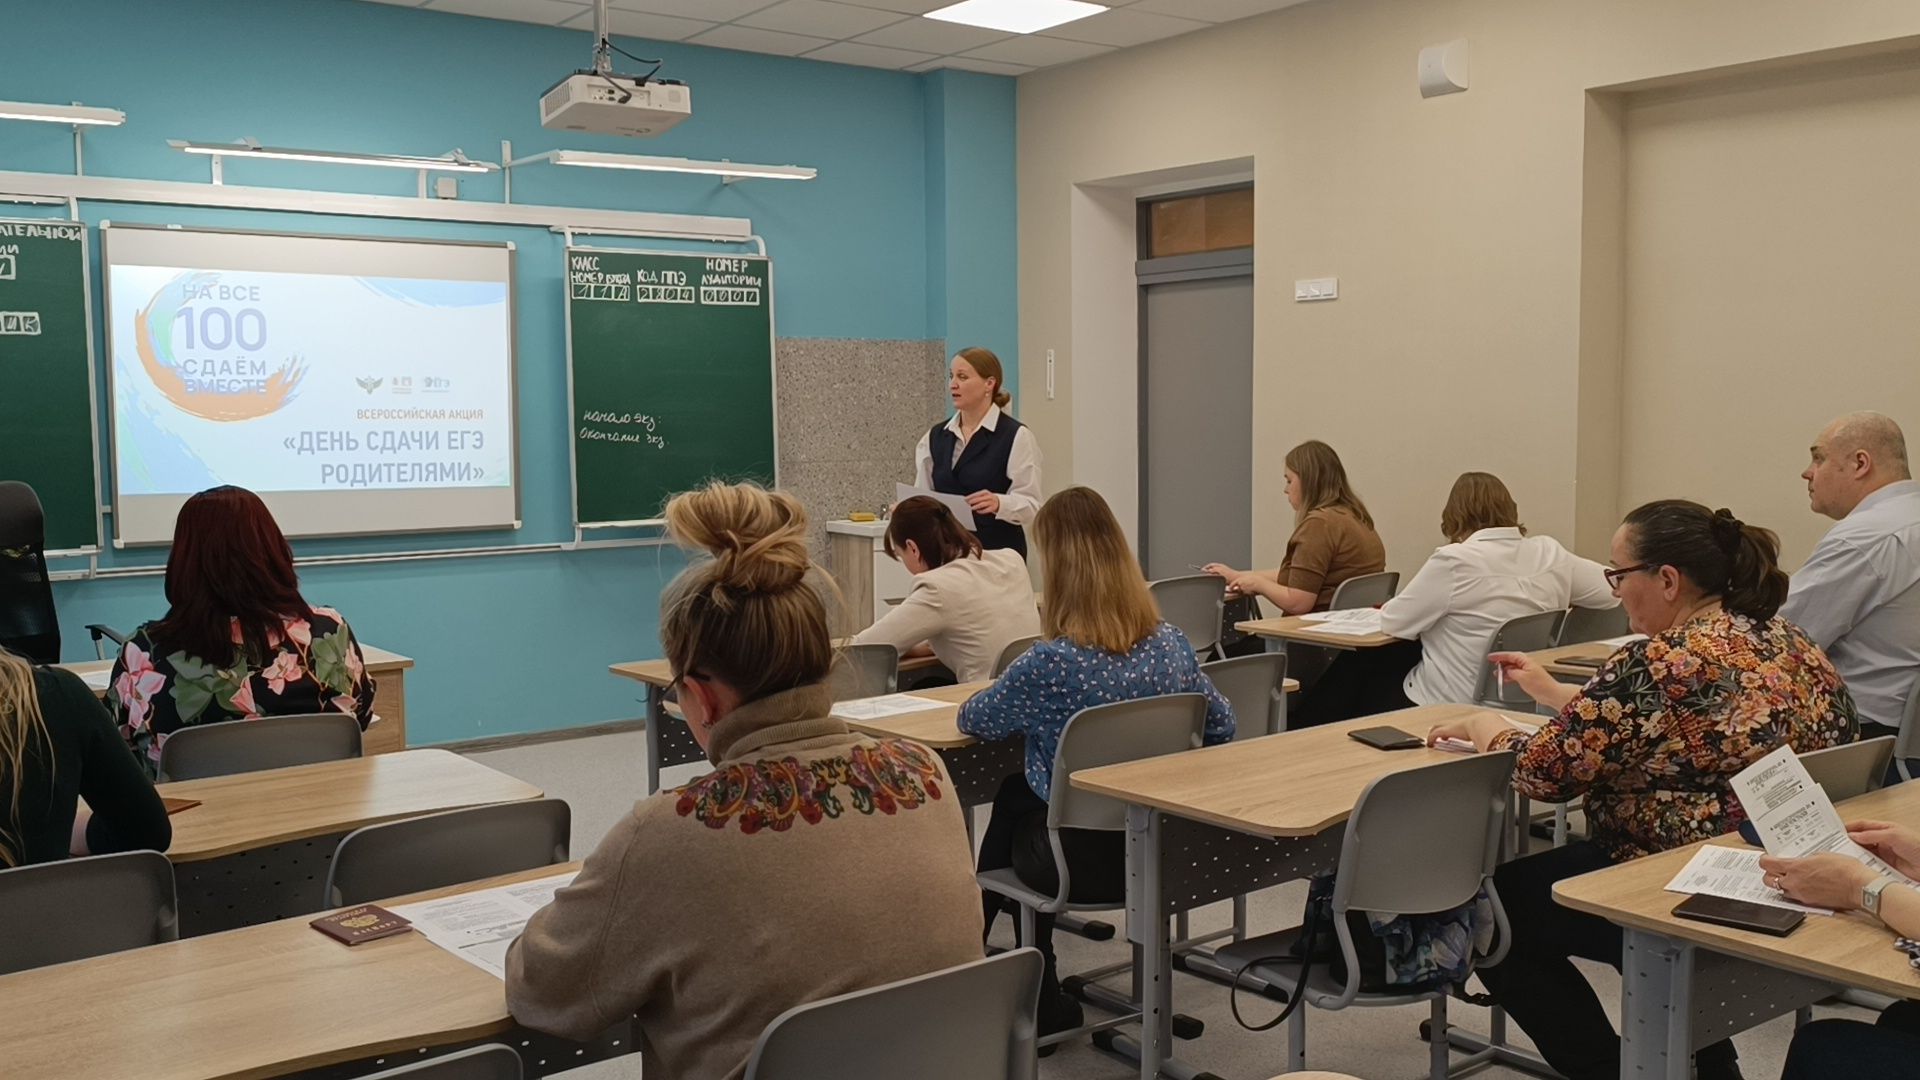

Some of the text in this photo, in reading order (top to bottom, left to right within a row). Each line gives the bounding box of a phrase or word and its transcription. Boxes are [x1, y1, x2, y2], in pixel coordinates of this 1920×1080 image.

[706, 258, 749, 273] НОМЕР
[637, 269, 687, 286] КОД ППЭ
[182, 284, 261, 302] НА ВСЕ
[176, 307, 268, 352] 100
[182, 356, 267, 378] СДАЁМ
[184, 378, 267, 395] ВМЕСТЕ
[357, 407, 484, 421] ВСЕРОССИЙСКАЯ АКЦИЯ
[283, 430, 484, 455] «ДЕНЬ СДАЧИ ЕГЭ
[321, 462, 485, 488] РОДИТЕЛЯМИ»
